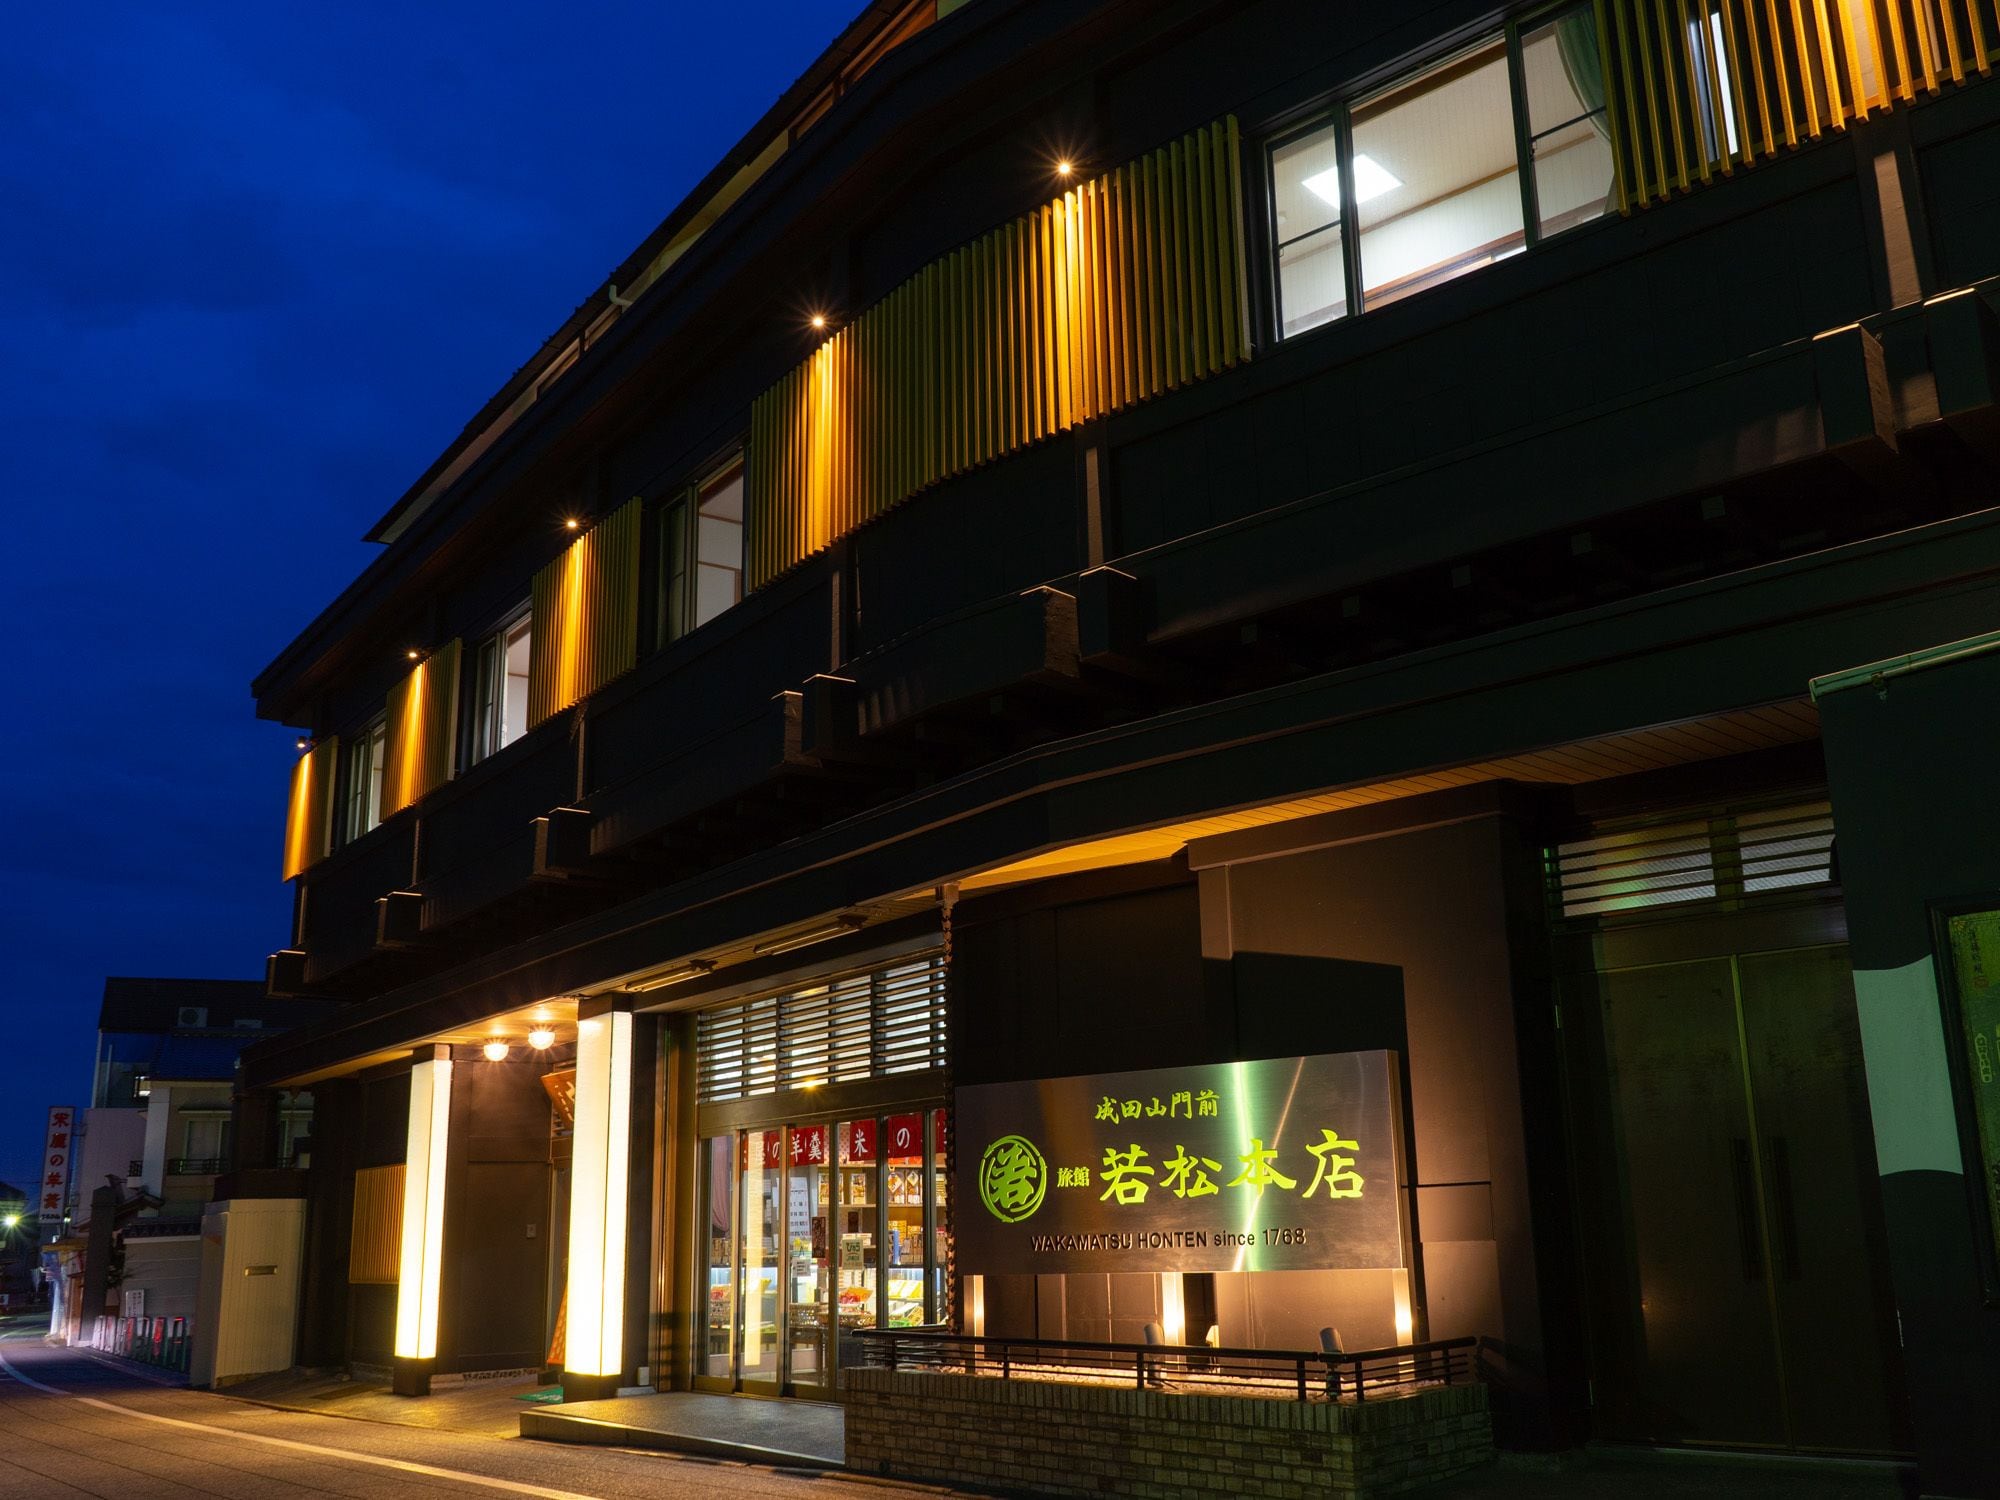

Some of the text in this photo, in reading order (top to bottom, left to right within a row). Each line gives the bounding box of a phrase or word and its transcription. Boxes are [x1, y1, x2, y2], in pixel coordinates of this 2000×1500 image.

[1095, 1089, 1220, 1125] 成田山門前
[1057, 1128, 1365, 1205] 旅館 若松本店
[1031, 1228, 1307, 1252] WAKAMATSU HONTEN since 1768
